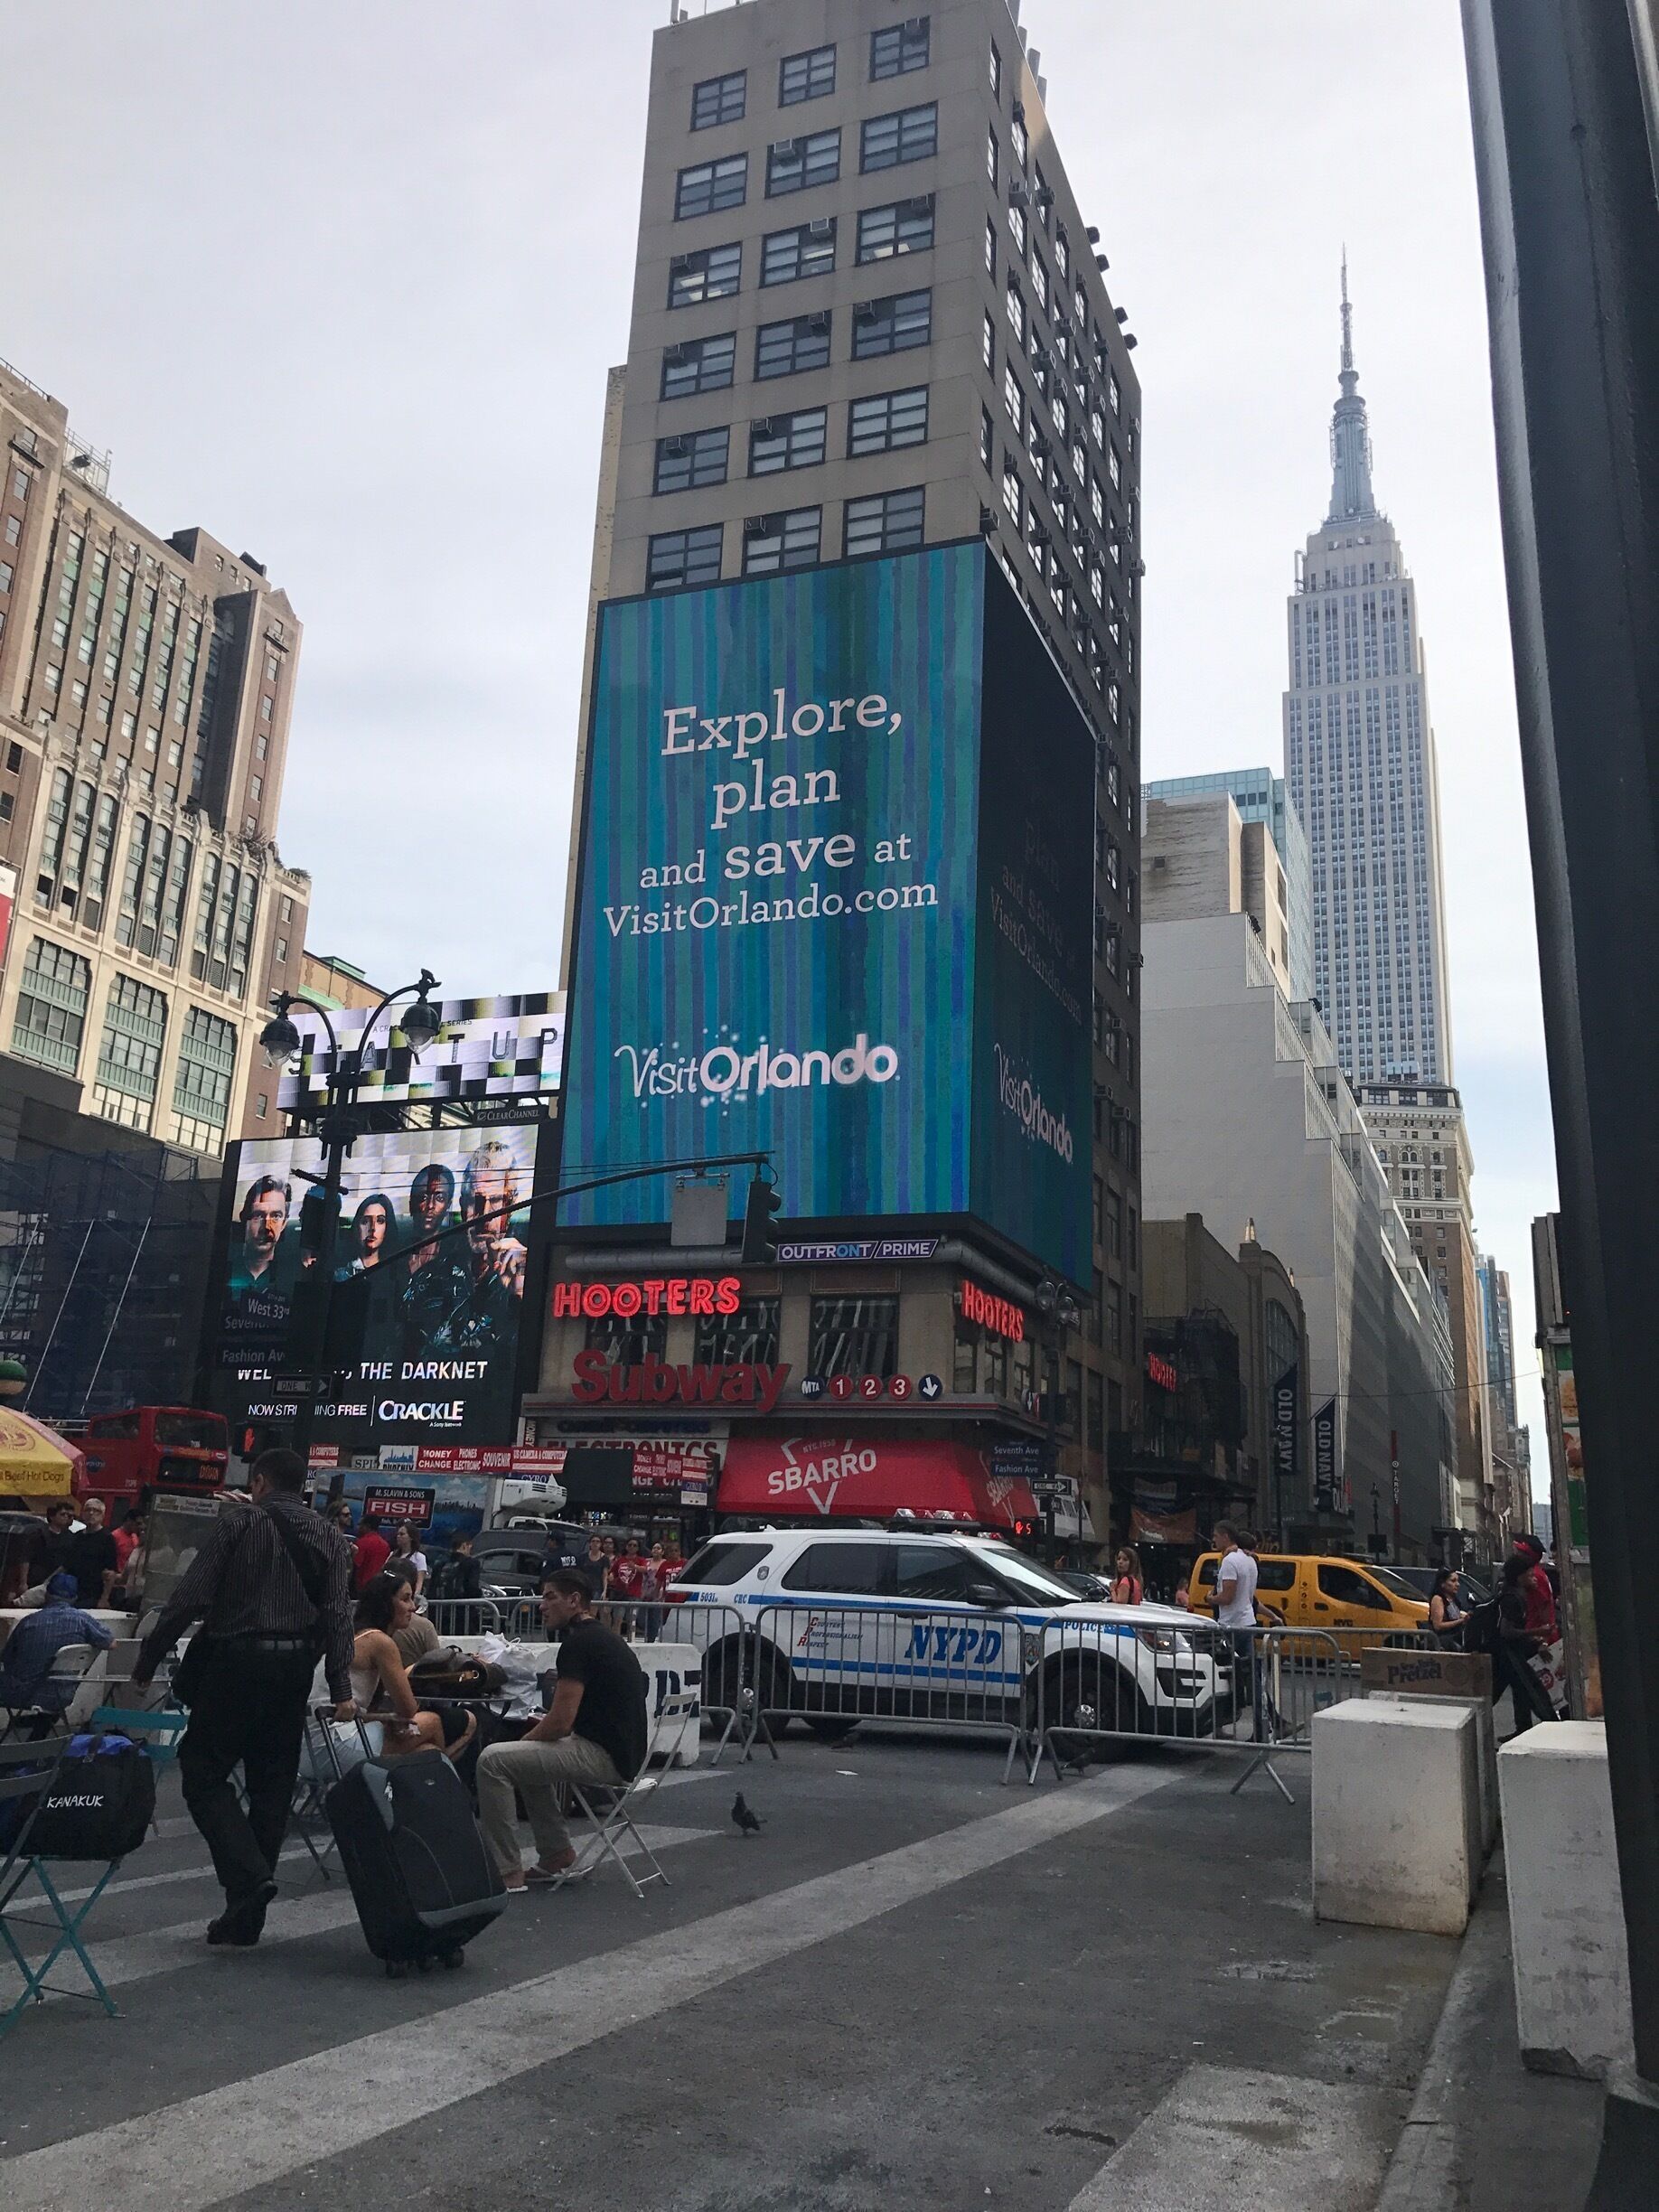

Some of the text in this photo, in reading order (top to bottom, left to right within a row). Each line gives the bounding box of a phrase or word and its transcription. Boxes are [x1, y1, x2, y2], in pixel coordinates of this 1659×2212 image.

[661, 688, 904, 759] Explore,
[710, 757, 841, 830] plan
[640, 833, 913, 889] and save at
[604, 883, 939, 937] VisitOrlando.com
[1002, 865, 1024, 907] and
[1027, 888, 1064, 960] save
[990, 884, 1083, 1026] VisitOrlando.com
[782, 1242, 931, 1259] OUTFRONT PRIME
[553, 1277, 741, 1317] HOOTERS
[248, 1298, 271, 1317] West
[961, 1279, 1025, 1343] HOOTERS
[222, 1348, 265, 1364] Fashion
[361, 1361, 488, 1380] THE DARKNET
[571, 1349, 792, 1413] Subway
[801, 1381, 820, 1394] MTA
[248, 1404, 273, 1416] NOW
[337, 1404, 368, 1416] FREE
[378, 1400, 464, 1420] CRACKLE
[1278, 1389, 1293, 1472] OLD NAVY
[423, 1449, 452, 1458] MONEY
[458, 1448, 477, 1457] PHONES
[483, 1452, 511, 1467] SOUVENIR
[994, 1447, 1038, 1455] Seventh Ave
[1317, 1420, 1331, 1493] OLD NAVY
[418, 1459, 452, 1468] CHANGE
[768, 1448, 876, 1495] SBARRO
[995, 1464, 1038, 1473] Fashion Ave
[5, 1470, 64, 1483] Beef Hot Dogs
[383, 1489, 405, 1497] SLAVIN
[370, 1502, 426, 1514] FISH
[1064, 1621, 1105, 1634] POLICE
[904, 1625, 1002, 1664] NYPD
[1387, 1663, 1443, 1685] Pretzel
[47, 1795, 104, 1808] KANAKUK
